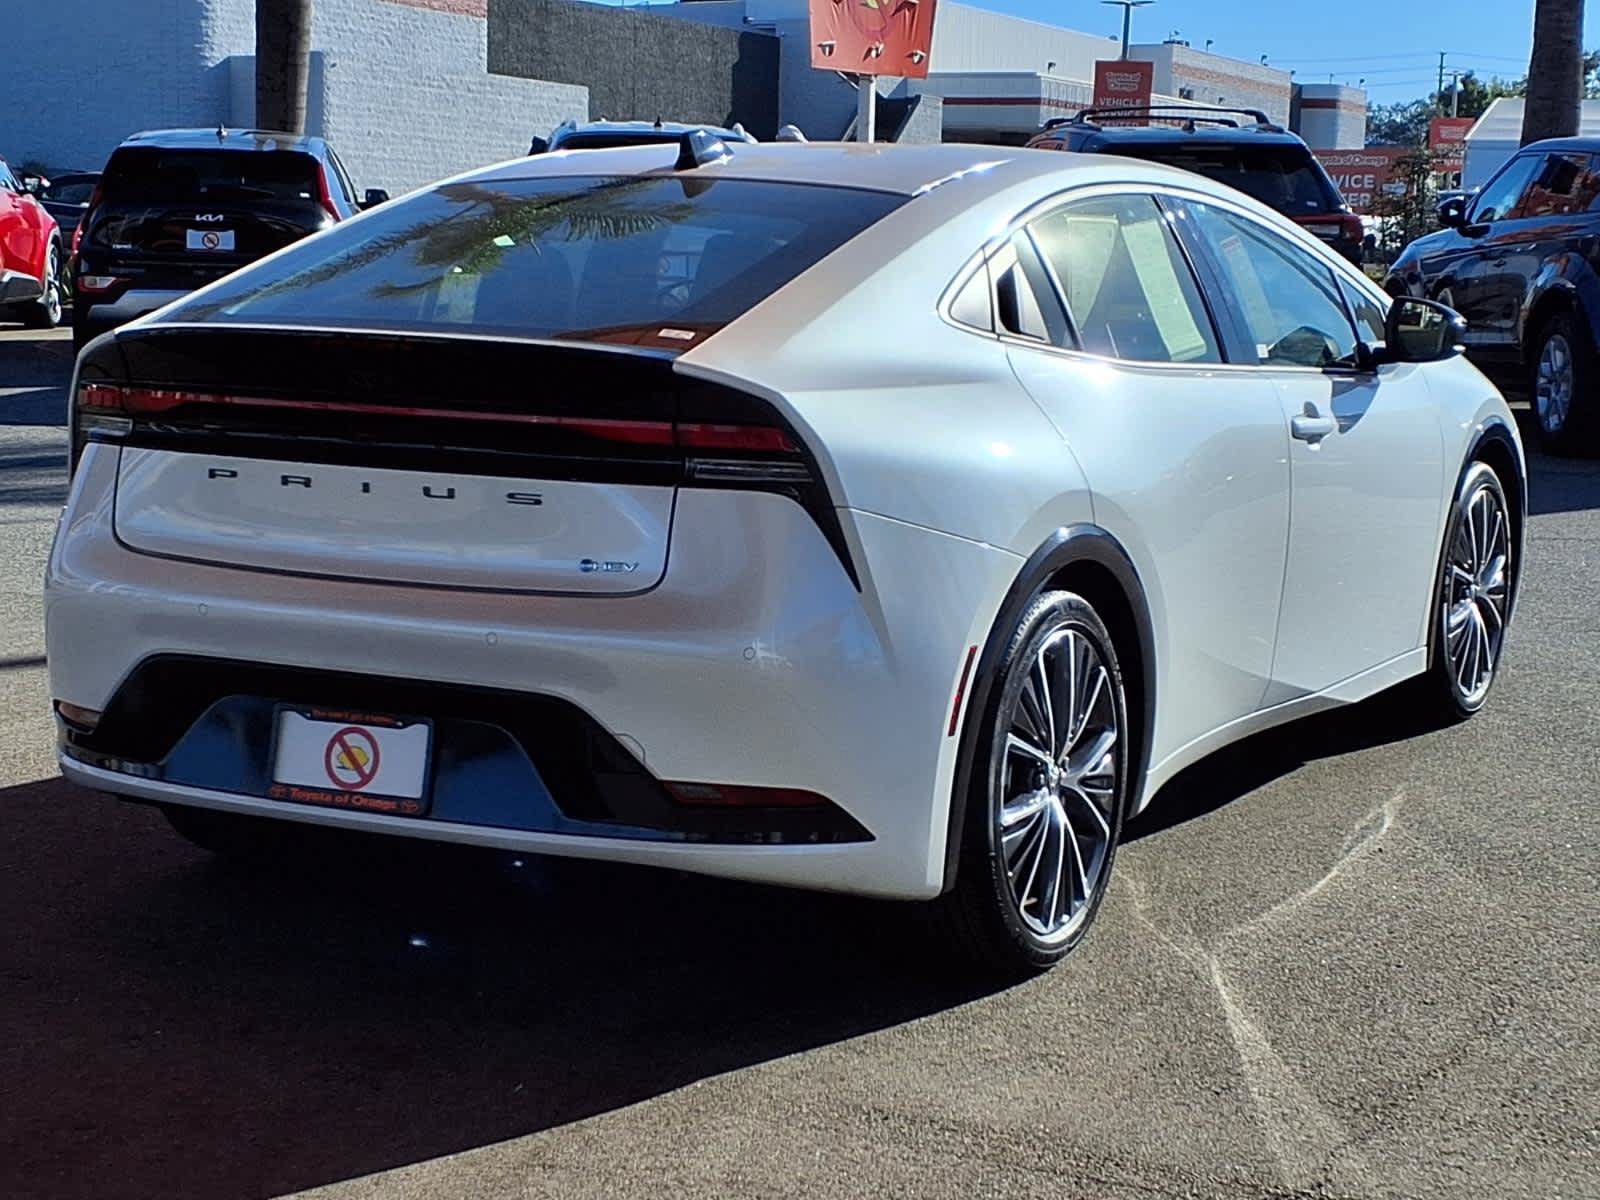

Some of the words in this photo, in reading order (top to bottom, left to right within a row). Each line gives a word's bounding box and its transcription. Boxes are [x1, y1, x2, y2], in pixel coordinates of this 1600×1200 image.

[1099, 97, 1143, 107] VEHICLE
[1331, 174, 1375, 189] VICE
[208, 468, 543, 506] PRIUS
